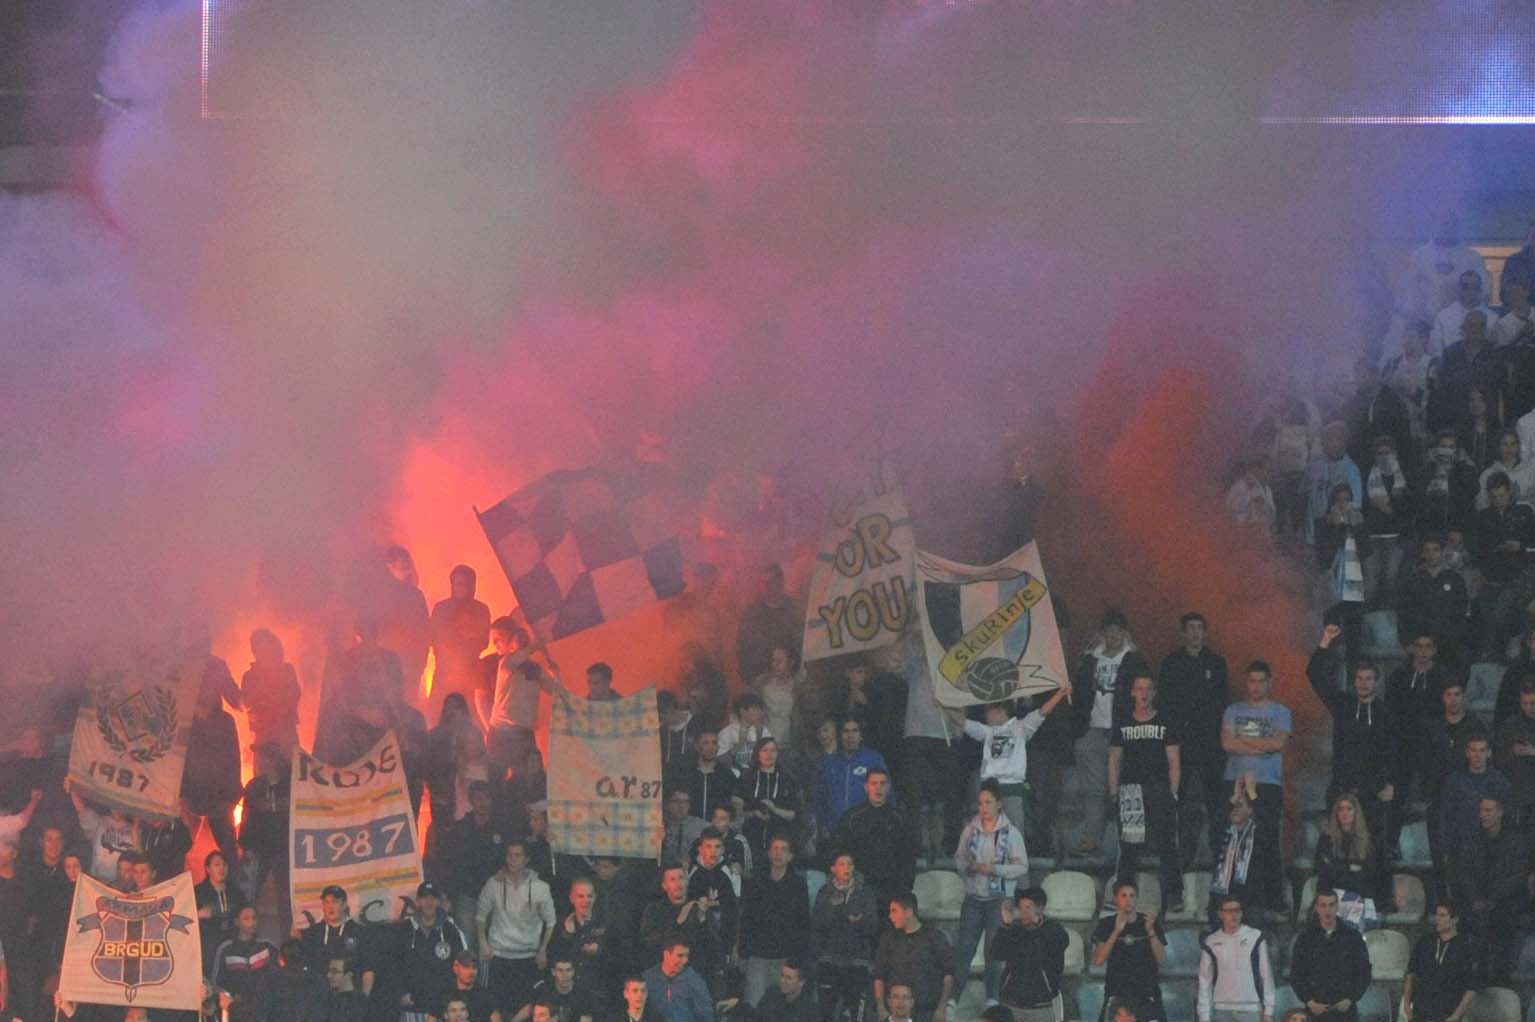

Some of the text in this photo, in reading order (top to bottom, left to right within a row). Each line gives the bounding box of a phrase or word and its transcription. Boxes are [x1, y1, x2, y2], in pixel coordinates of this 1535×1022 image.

[834, 513, 902, 577] OR
[818, 575, 911, 648] YOU
[301, 820, 406, 864] 1987
[103, 942, 165, 957] BRGUD
